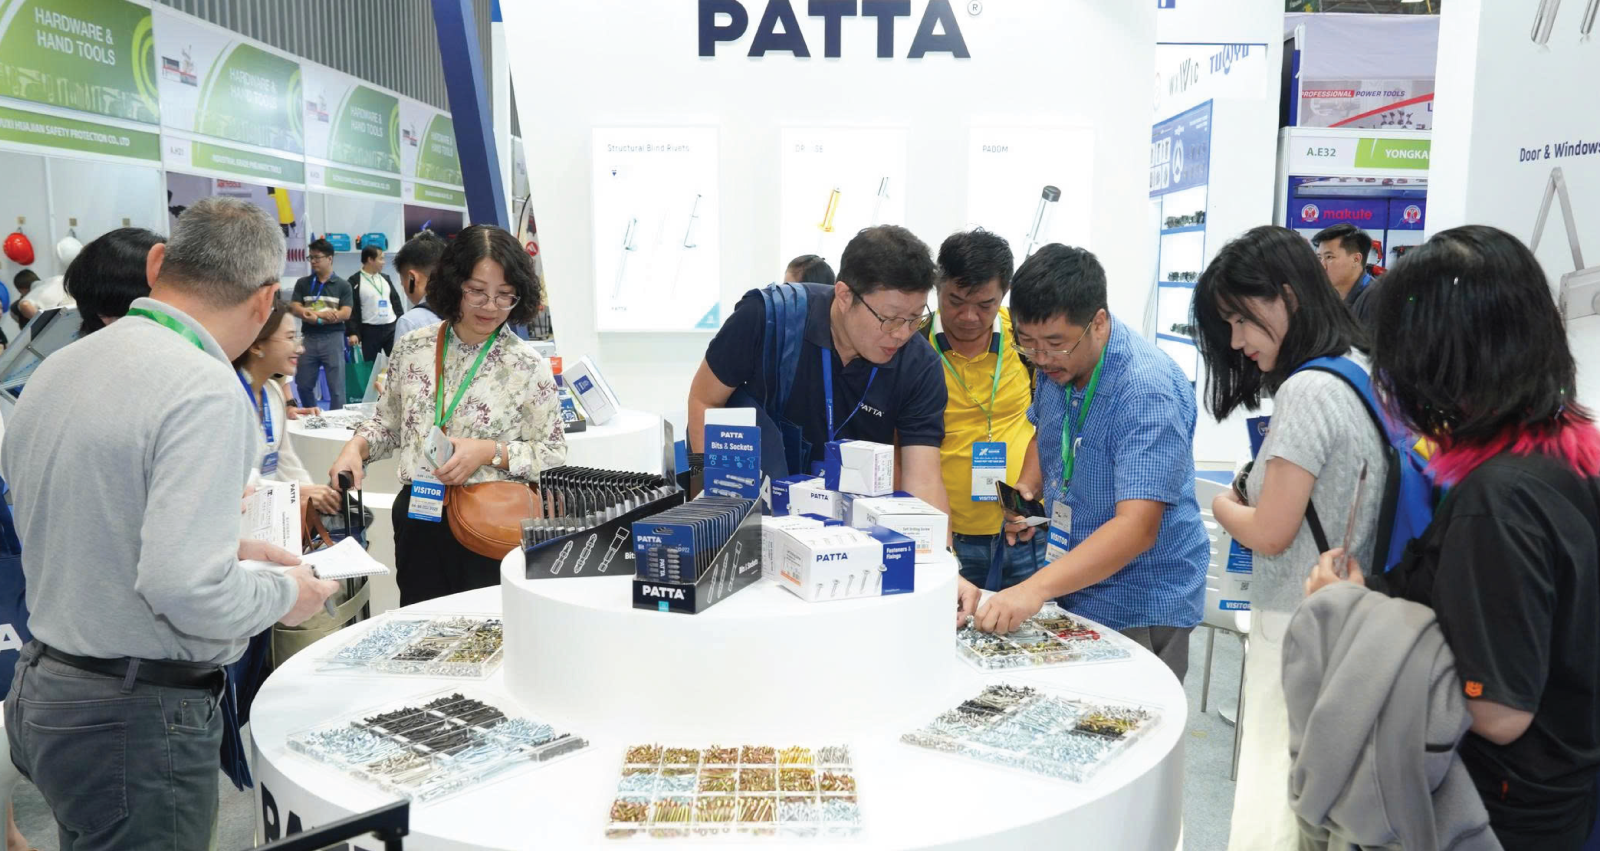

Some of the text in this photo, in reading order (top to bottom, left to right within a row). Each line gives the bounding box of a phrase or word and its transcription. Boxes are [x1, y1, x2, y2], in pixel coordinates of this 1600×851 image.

[34, 7, 114, 45] HARDWARE &
[698, 0, 971, 59] PATTA
[36, 29, 116, 66] HAND TOOLS
[1302, 90, 1352, 98] PROFESSIONAL
[46, 125, 70, 138] SAFETY
[70, 129, 107, 143] PROTECTION
[607, 144, 645, 152] Structural
[647, 144, 665, 152] Blind
[1306, 147, 1336, 157] A.E32
[1519, 147, 1541, 162] Door
[1544, 144, 1550, 159] &
[1323, 208, 1373, 220] makute
[859, 402, 882, 418] PATTA
[721, 431, 744, 439] PATTA
[711, 442, 723, 450] Bits
[730, 443, 754, 451] Sockets
[413, 485, 442, 497] VISITOR
[810, 492, 829, 500] PATTA
[637, 535, 662, 544] PATTA
[1050, 532, 1068, 547] VISITOR
[886, 546, 908, 554] Fasteners
[816, 552, 848, 562] PATTA
[642, 585, 685, 600] PATTA
